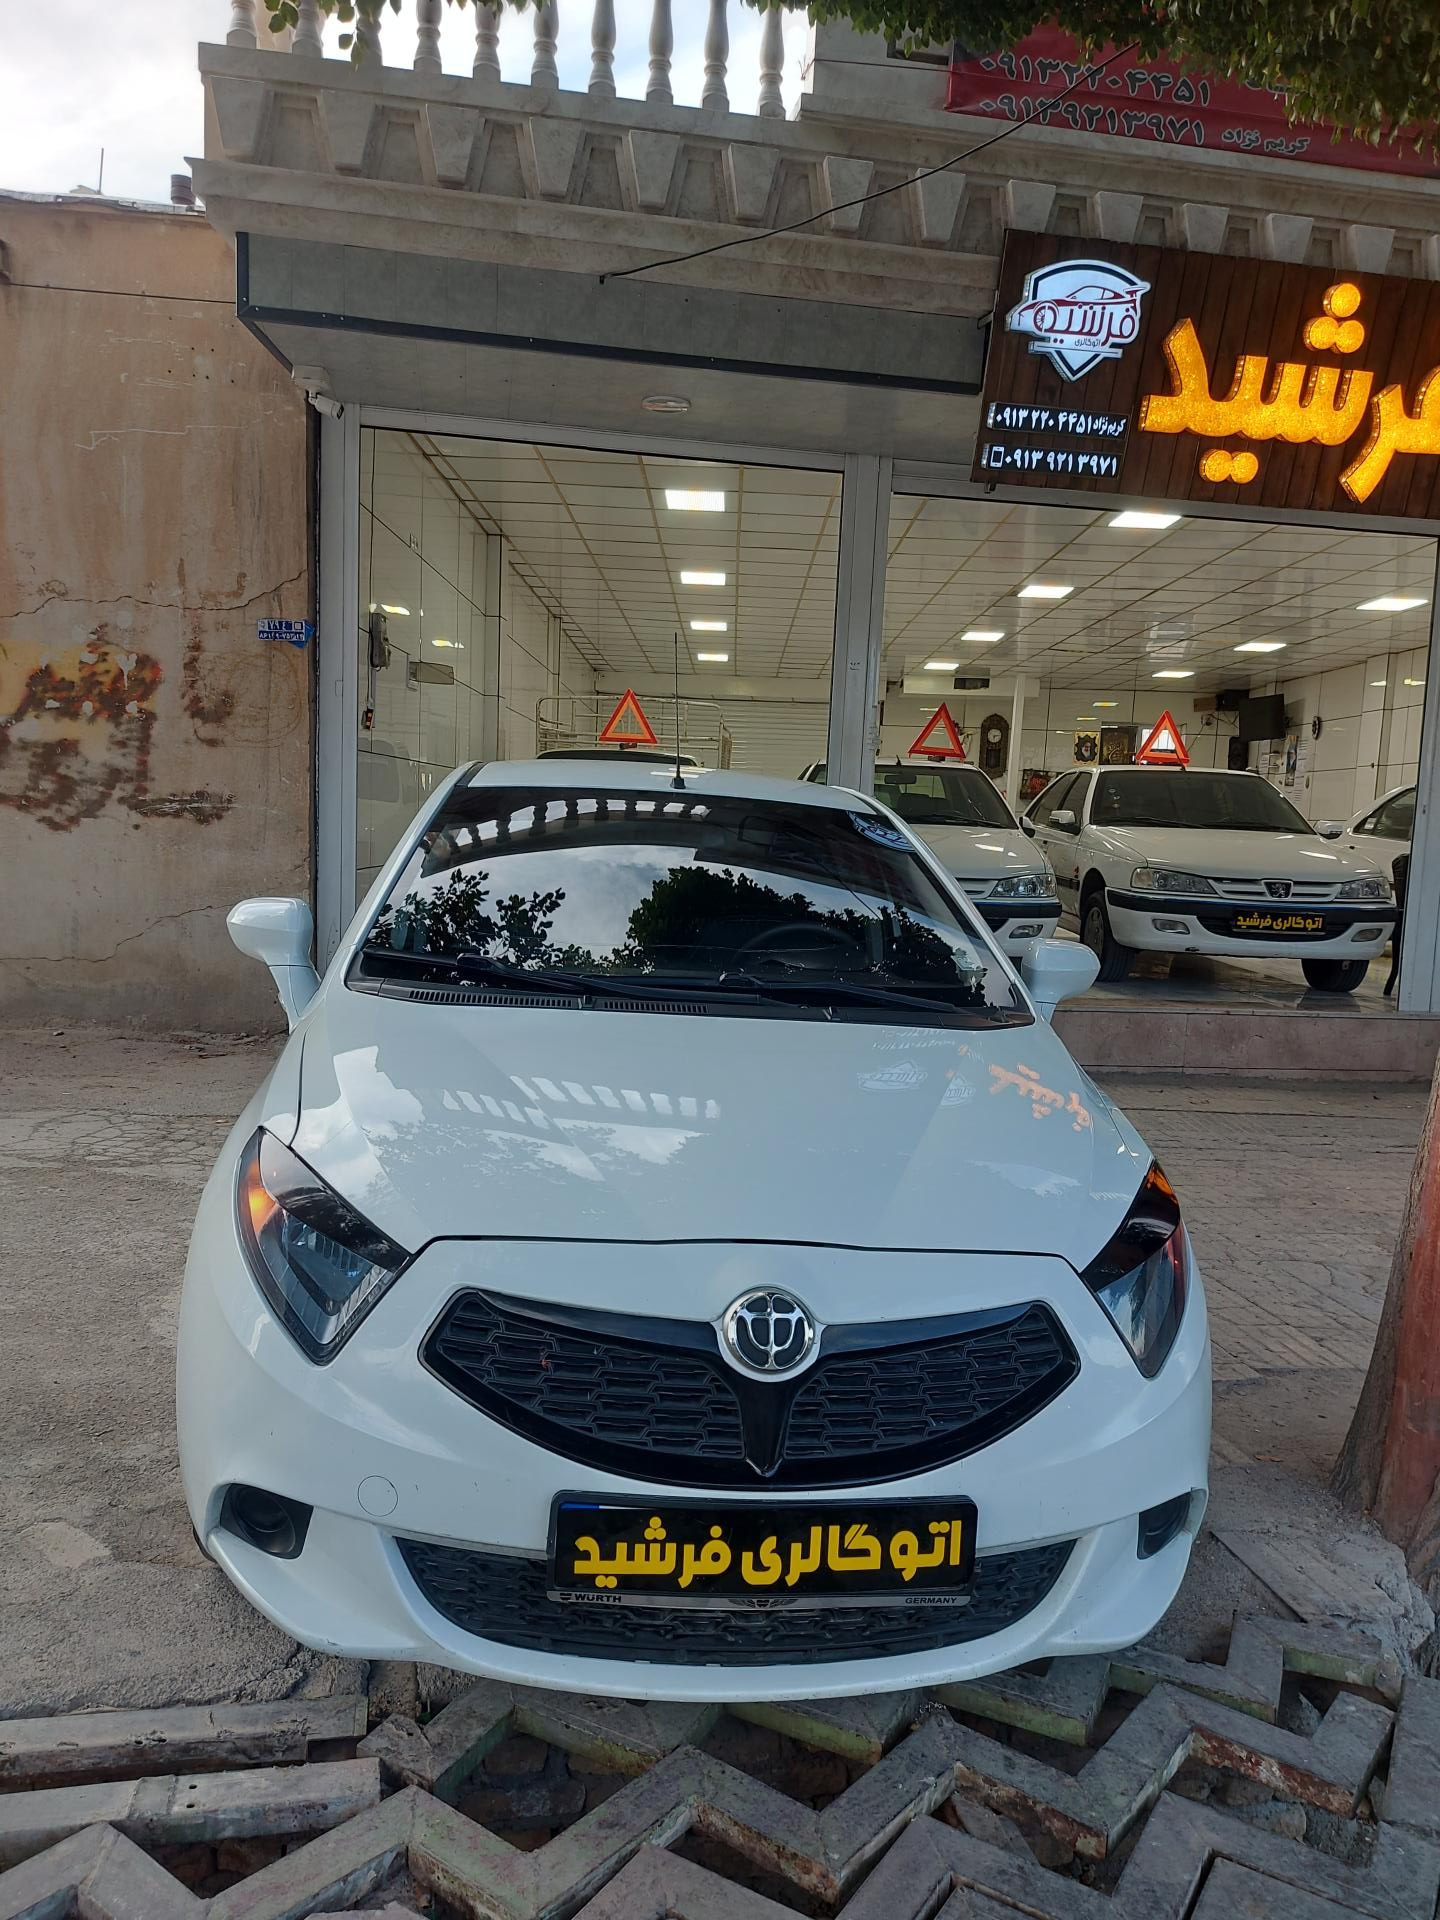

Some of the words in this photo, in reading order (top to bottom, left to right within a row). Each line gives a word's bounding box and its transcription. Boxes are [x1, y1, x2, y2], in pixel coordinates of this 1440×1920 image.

[979, 93, 1205, 146] ۰۹۱۳۹۲۱۳۹۷۱
[573, 1516, 732, 1589] فرشید
[741, 1524, 881, 1586] گالری
[890, 1519, 962, 1582] اتو
